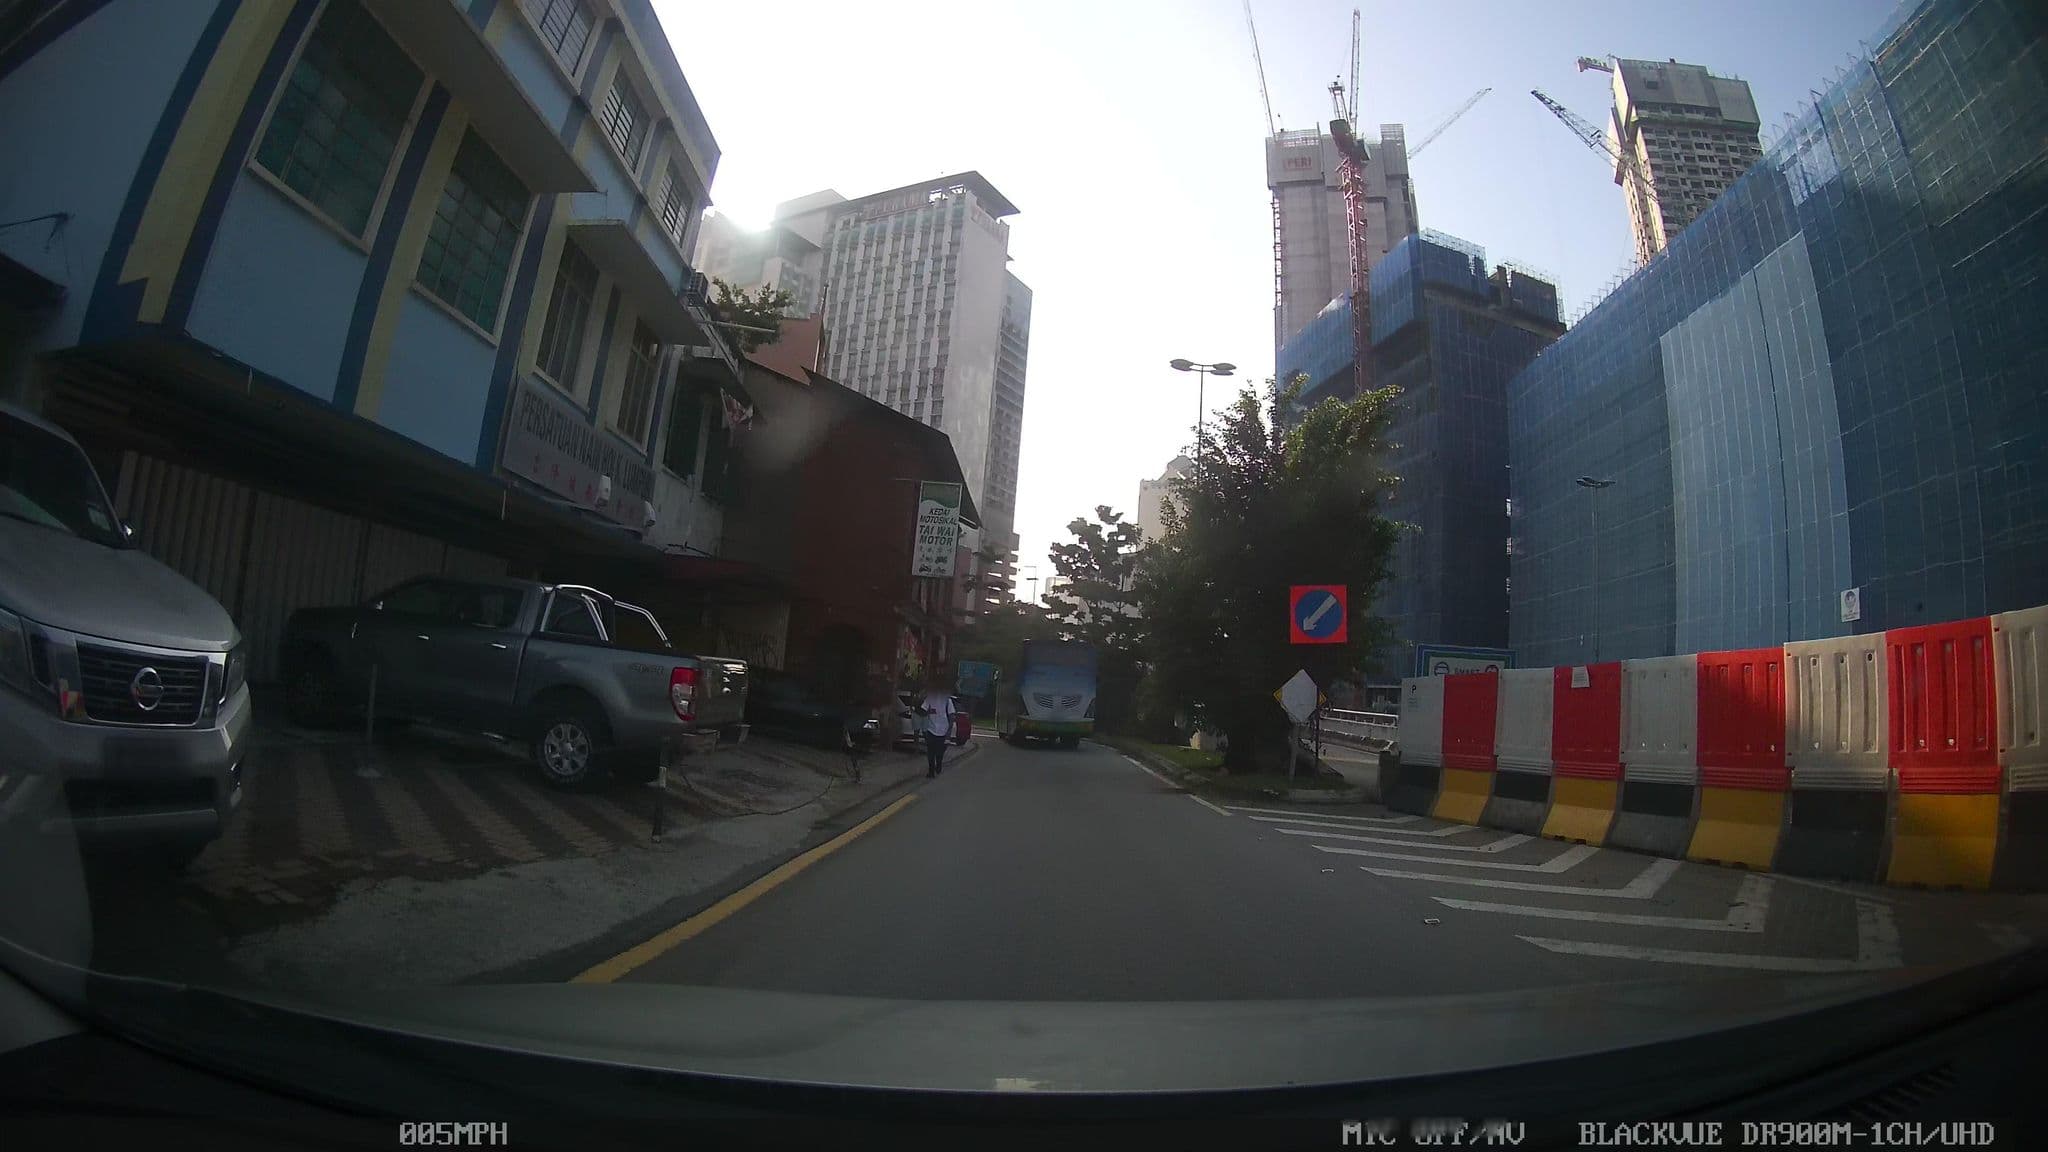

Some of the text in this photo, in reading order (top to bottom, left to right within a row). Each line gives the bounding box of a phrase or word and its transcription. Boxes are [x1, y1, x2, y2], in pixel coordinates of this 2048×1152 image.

[518, 391, 580, 462] PERSATUAN
[928, 508, 951, 516] KEDAI
[919, 515, 958, 526] MOTOSIKAL
[919, 525, 955, 537] TAI WAI
[919, 535, 953, 546] MOTOR
